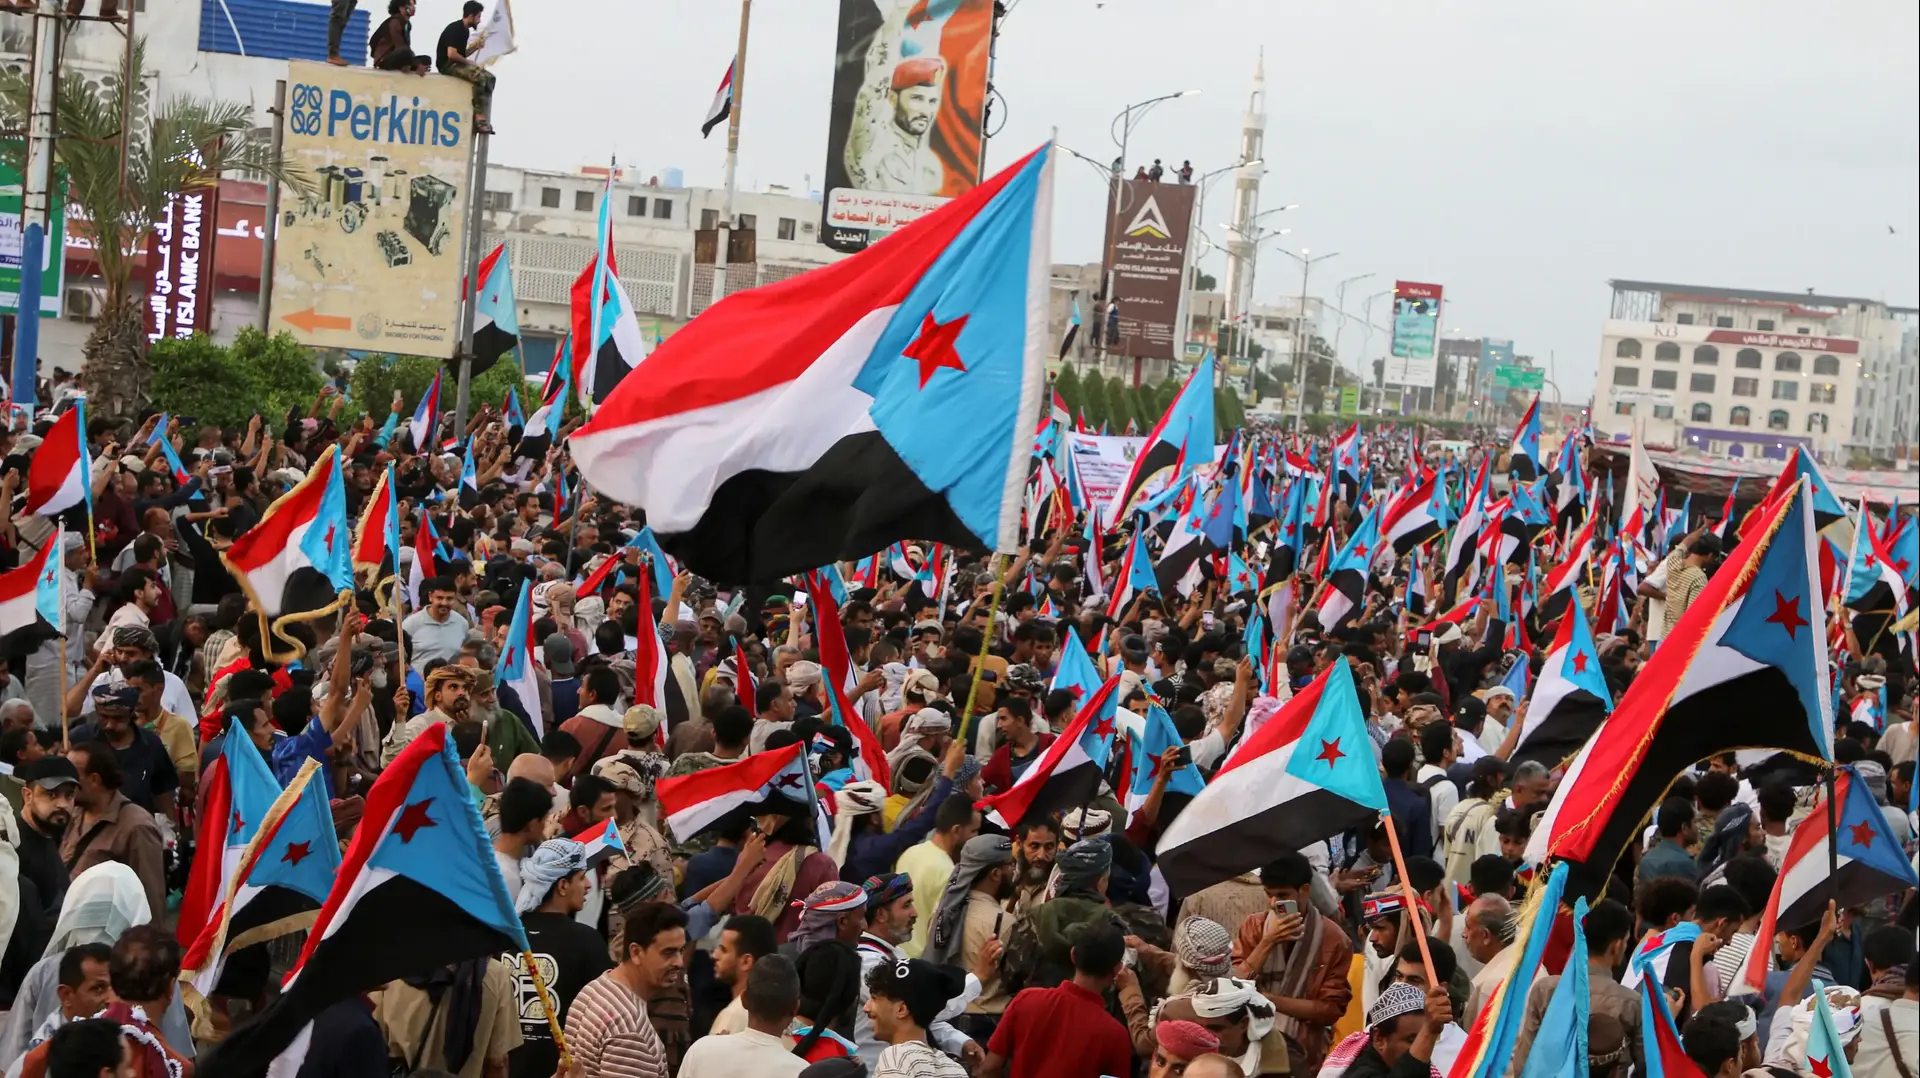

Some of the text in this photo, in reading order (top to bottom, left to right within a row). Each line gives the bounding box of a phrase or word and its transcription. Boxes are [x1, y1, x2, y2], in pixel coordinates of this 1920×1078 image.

[328, 89, 461, 147] Perkins
[182, 194, 203, 250] BANK
[833, 229, 867, 245] الحديث
[156, 244, 173, 295] عدن
[176, 251, 199, 325] ISLAMIC
[1131, 264, 1159, 273] ISLAMIC
[1159, 266, 1180, 275] BANK
